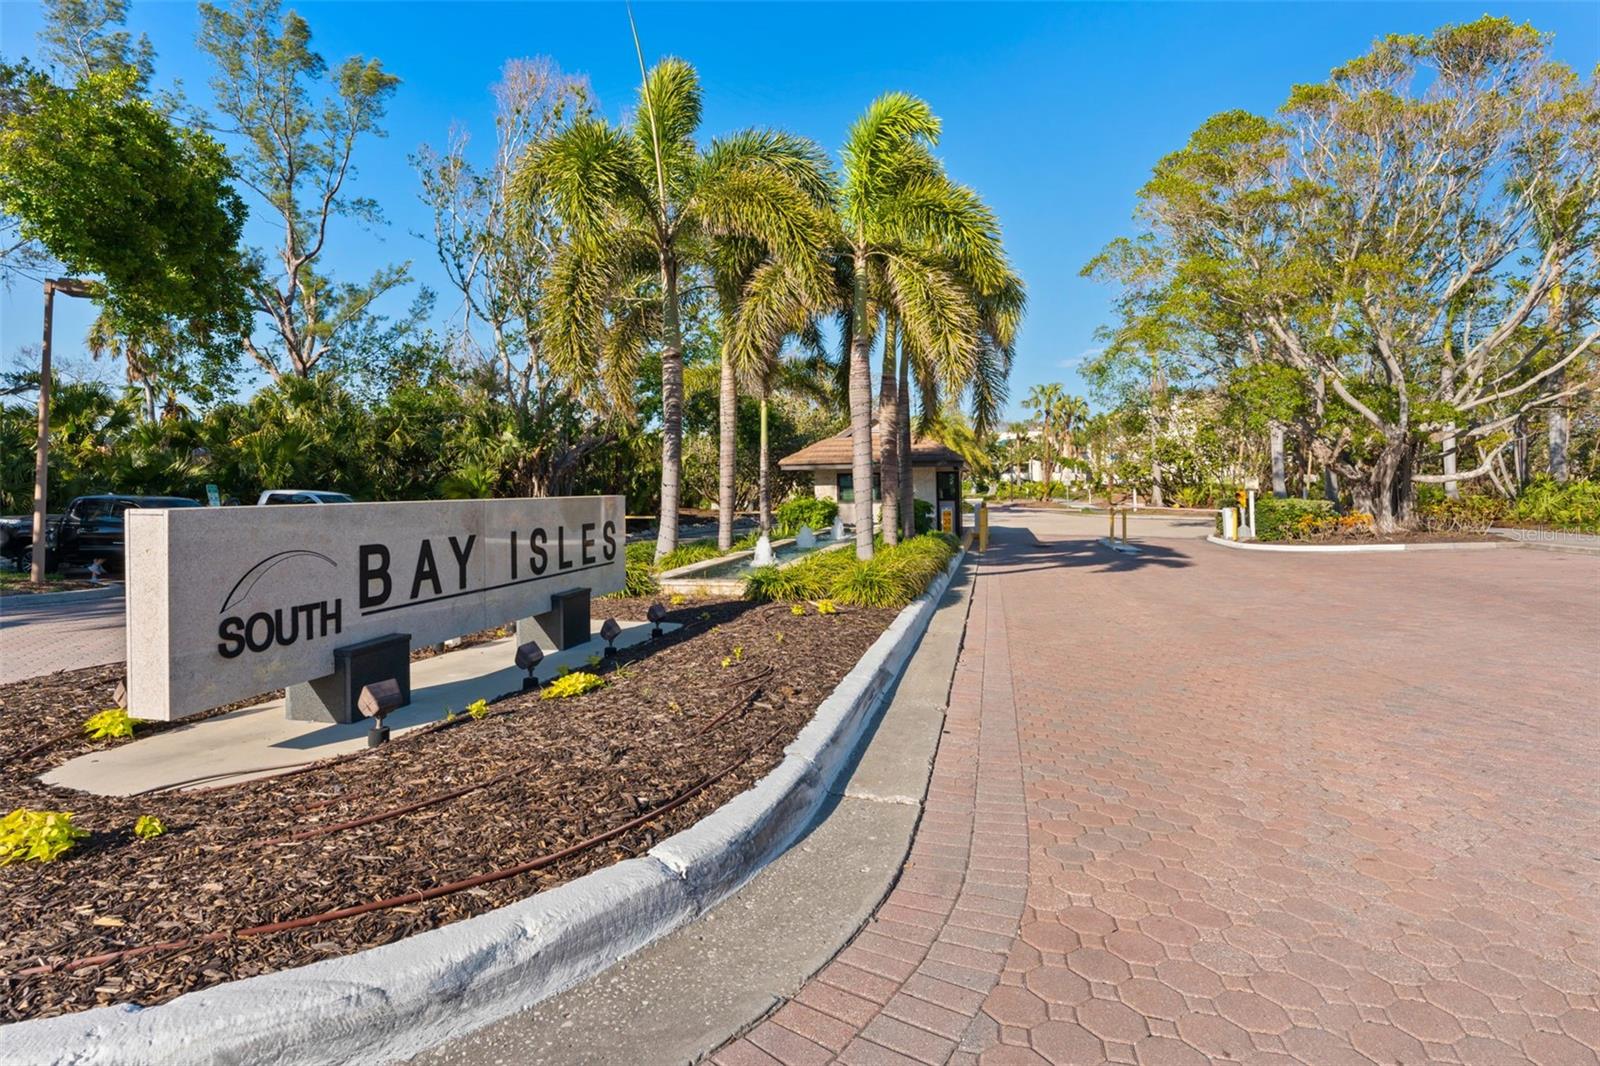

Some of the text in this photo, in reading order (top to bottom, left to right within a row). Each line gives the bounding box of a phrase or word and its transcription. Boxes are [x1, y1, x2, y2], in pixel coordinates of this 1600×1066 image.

[218, 520, 617, 659] SOUTH BAY ISLES
